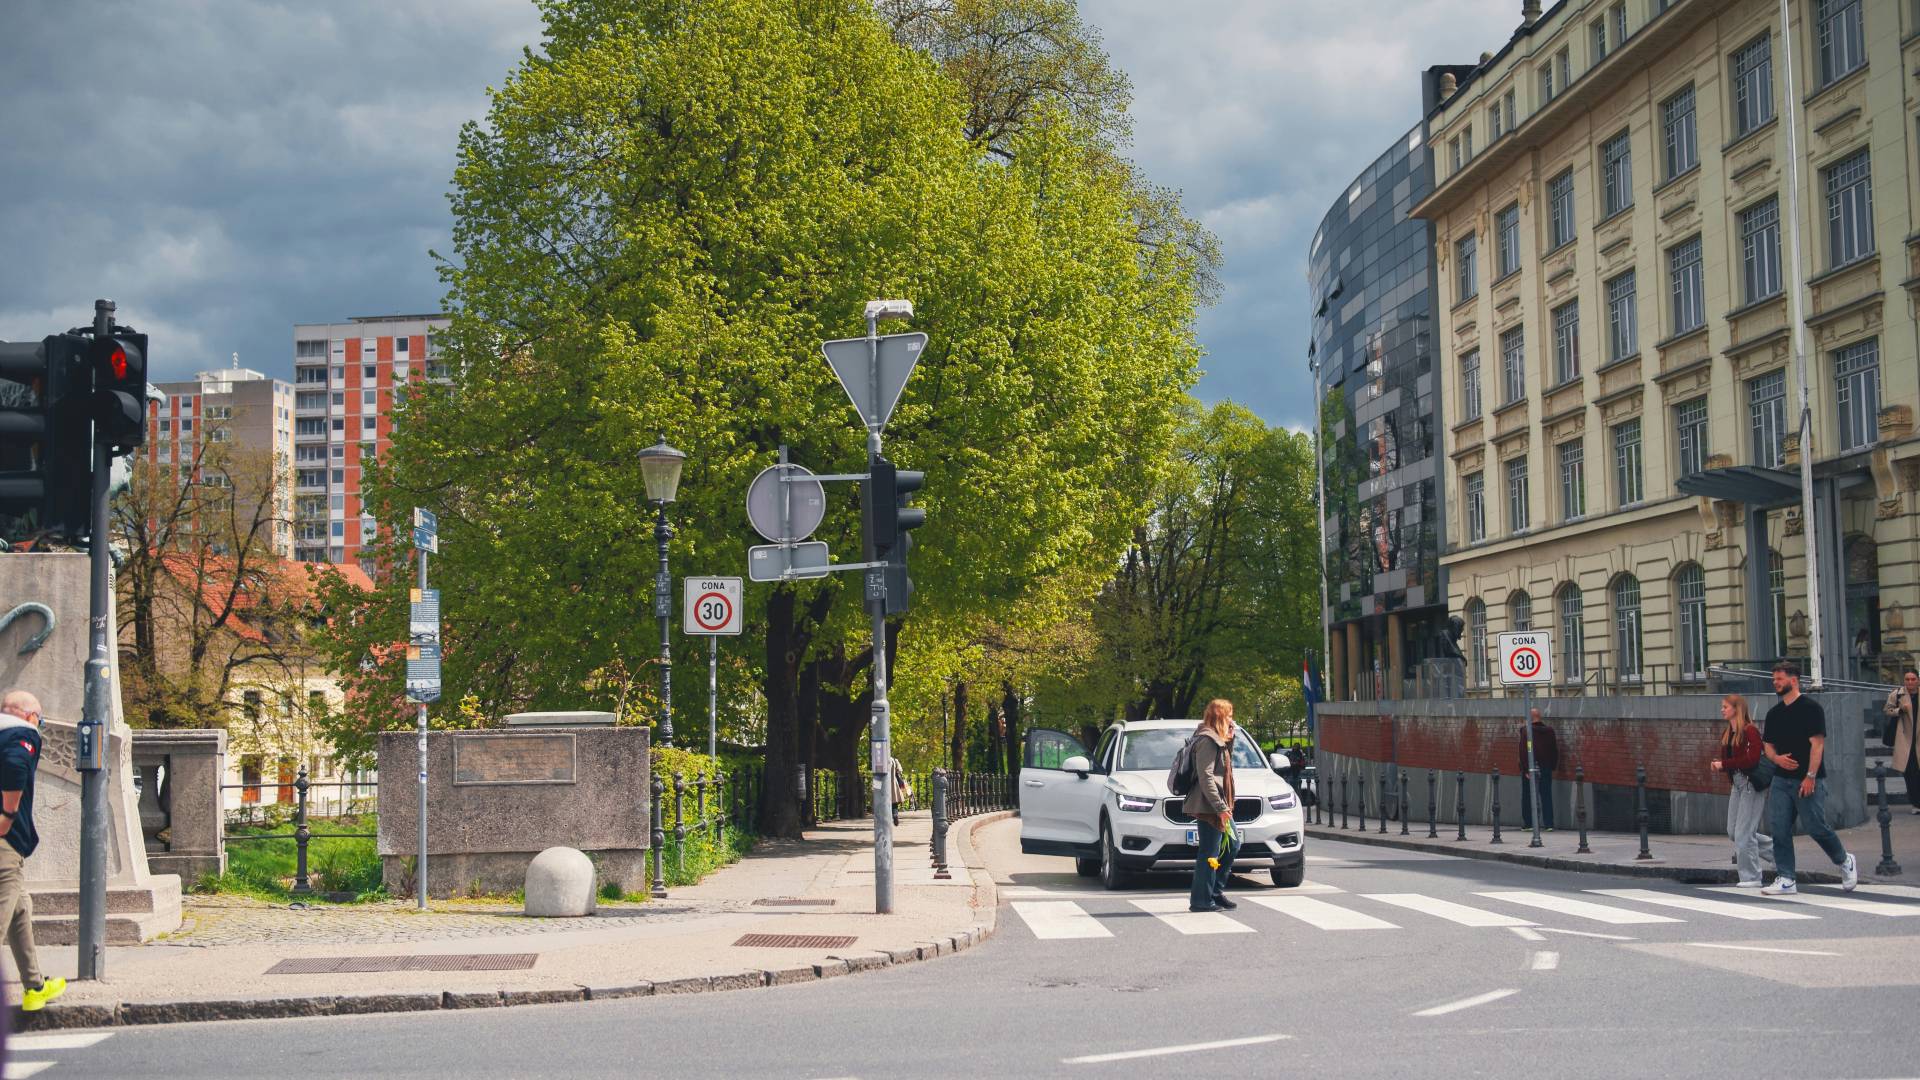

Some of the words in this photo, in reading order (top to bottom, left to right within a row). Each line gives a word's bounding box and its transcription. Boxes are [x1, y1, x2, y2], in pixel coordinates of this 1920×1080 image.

[702, 581, 725, 590] CONA
[703, 602, 724, 620] 30
[1512, 636, 1537, 645] CONA
[1516, 654, 1535, 671] 30
